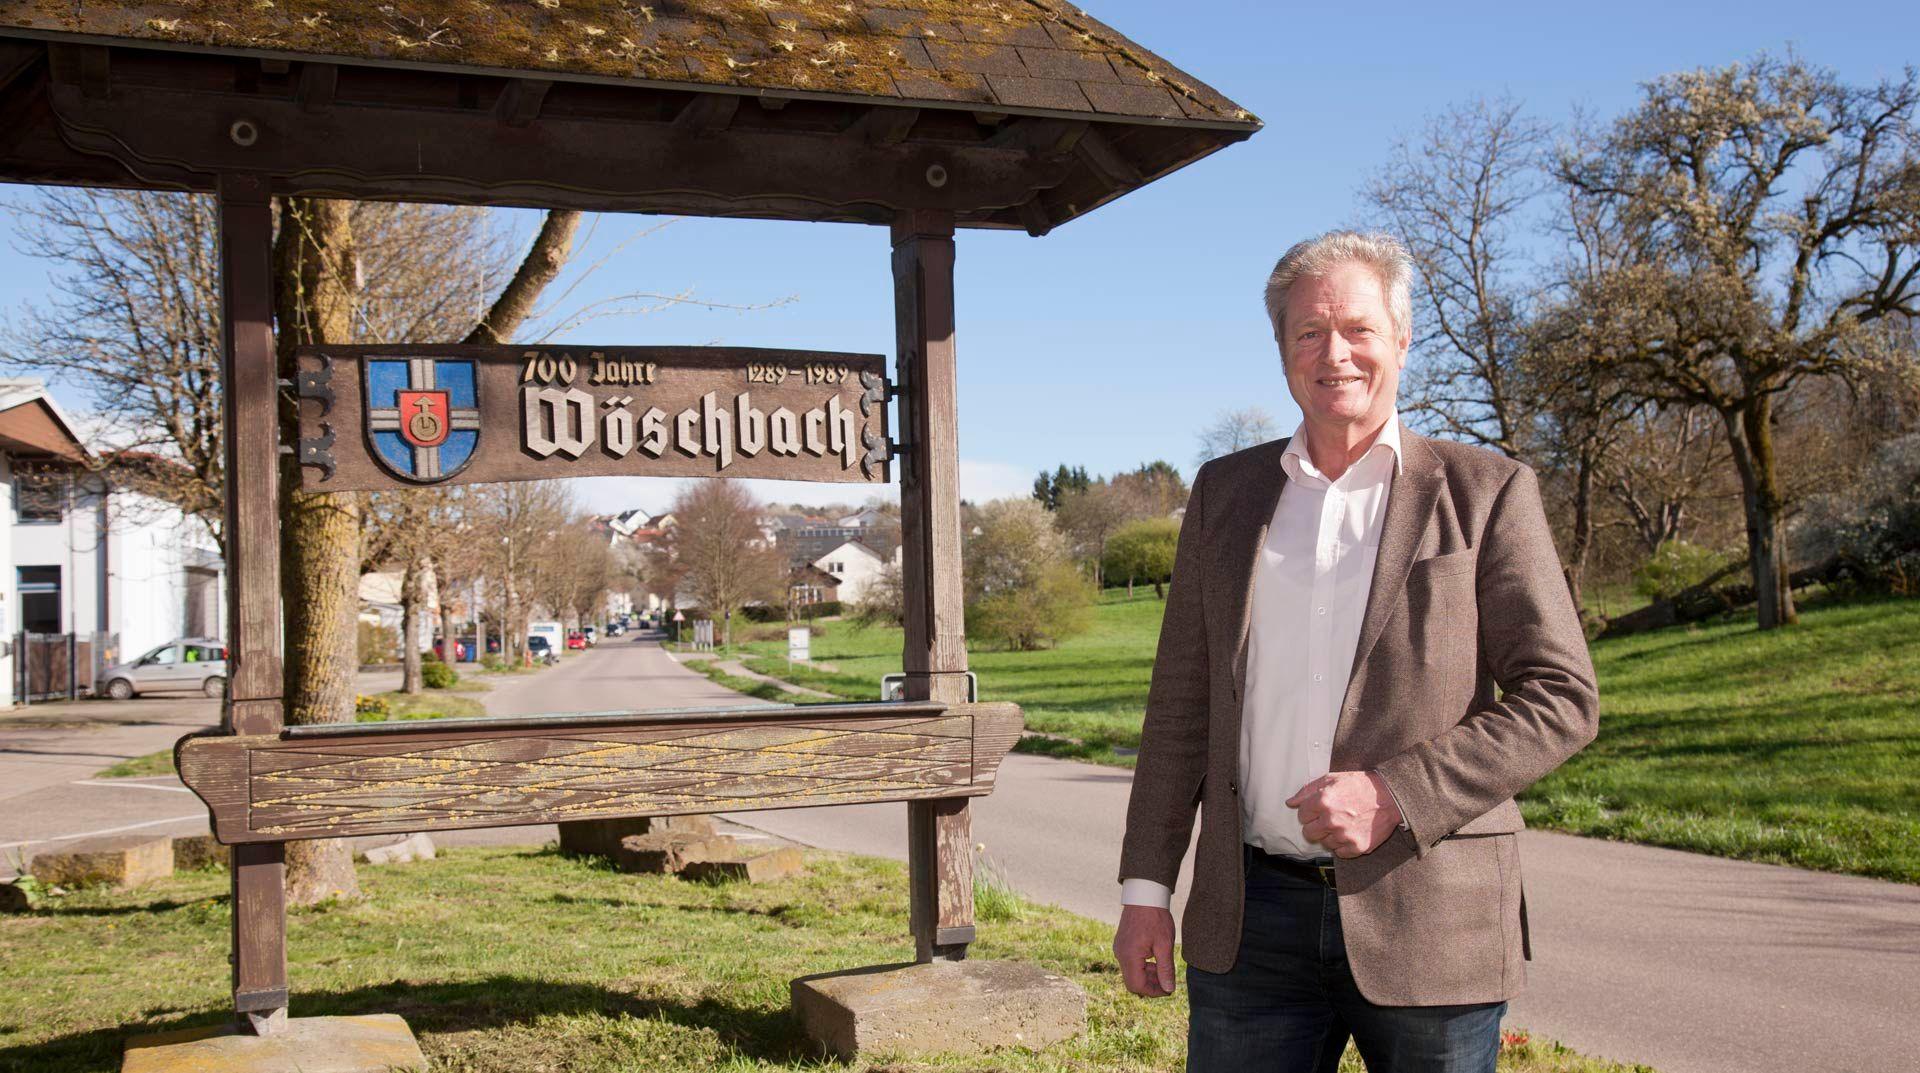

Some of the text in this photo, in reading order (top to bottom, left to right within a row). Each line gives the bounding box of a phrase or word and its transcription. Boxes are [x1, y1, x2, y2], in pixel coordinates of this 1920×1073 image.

[521, 351, 657, 385] 700 Jahre
[521, 386, 856, 471] Wöschbach
